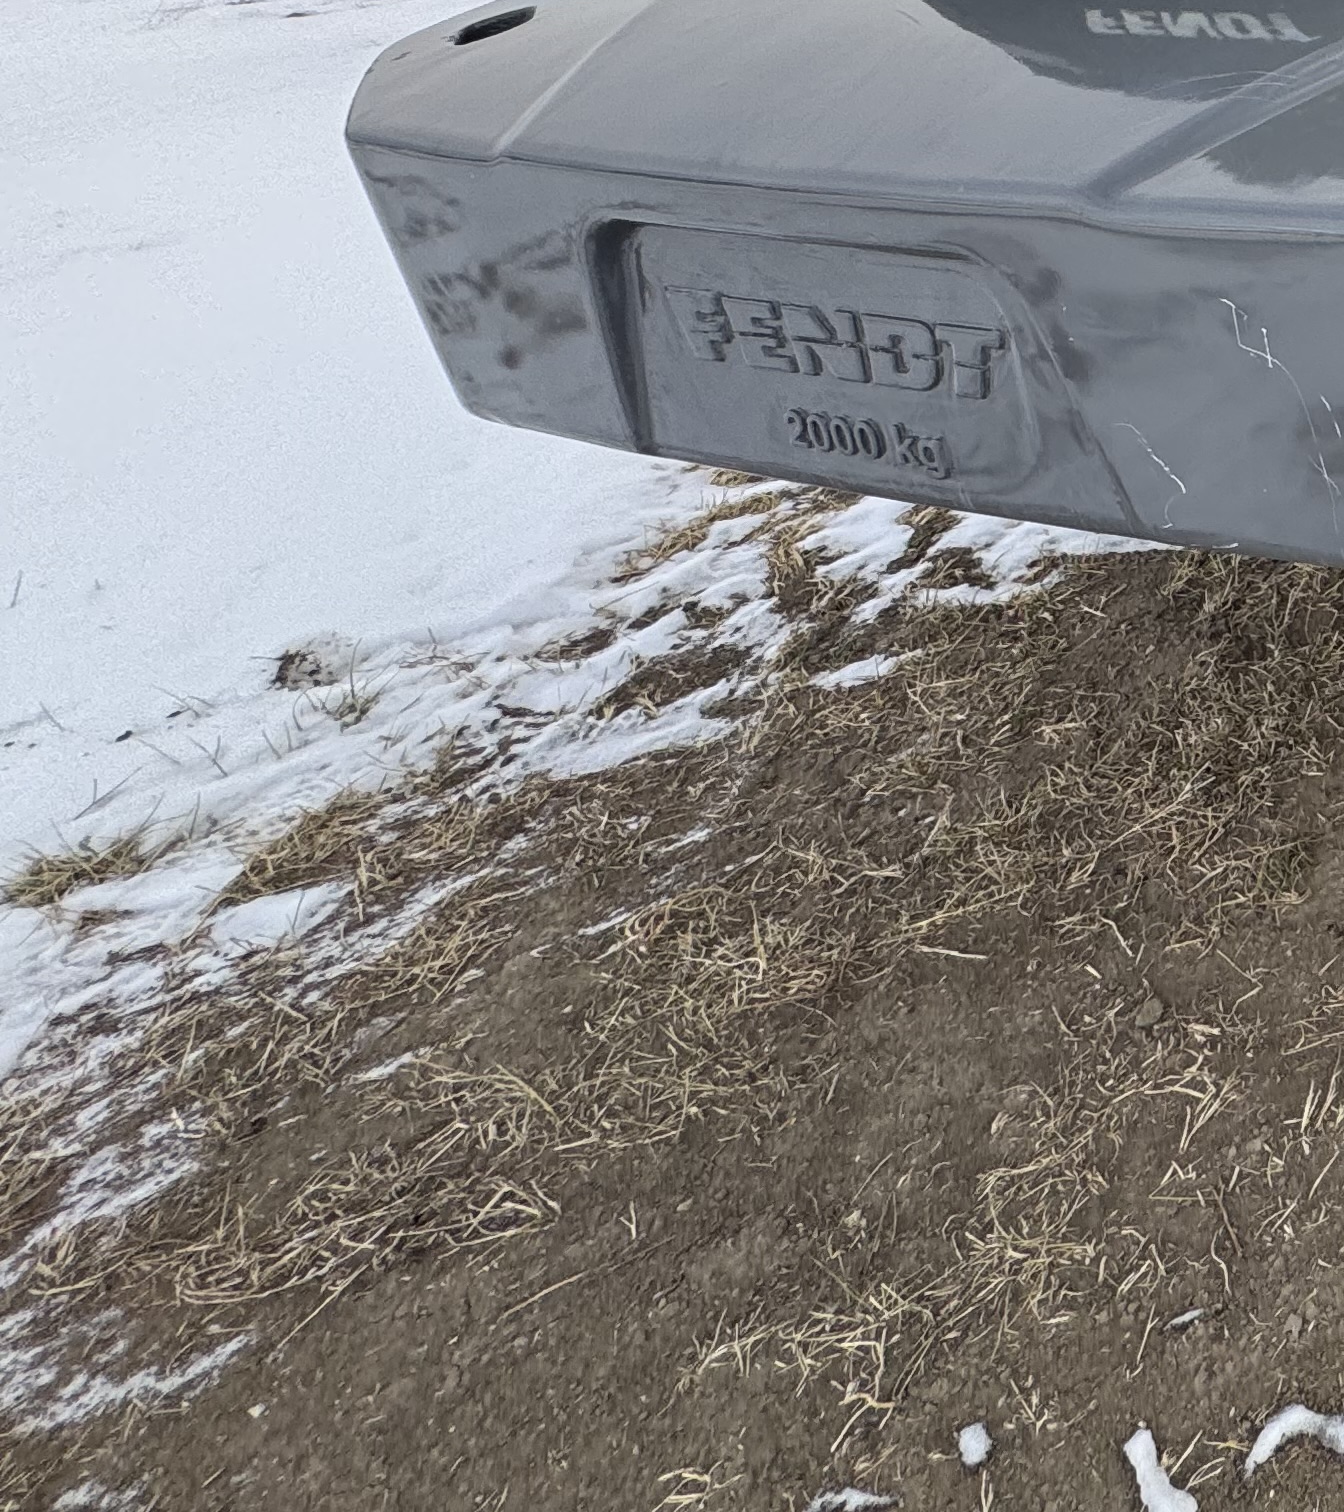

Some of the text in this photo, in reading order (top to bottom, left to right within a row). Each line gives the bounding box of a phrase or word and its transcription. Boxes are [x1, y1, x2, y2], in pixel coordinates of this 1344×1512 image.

[664, 286, 1006, 399] FENDT
[784, 408, 952, 480] 2000 kg
